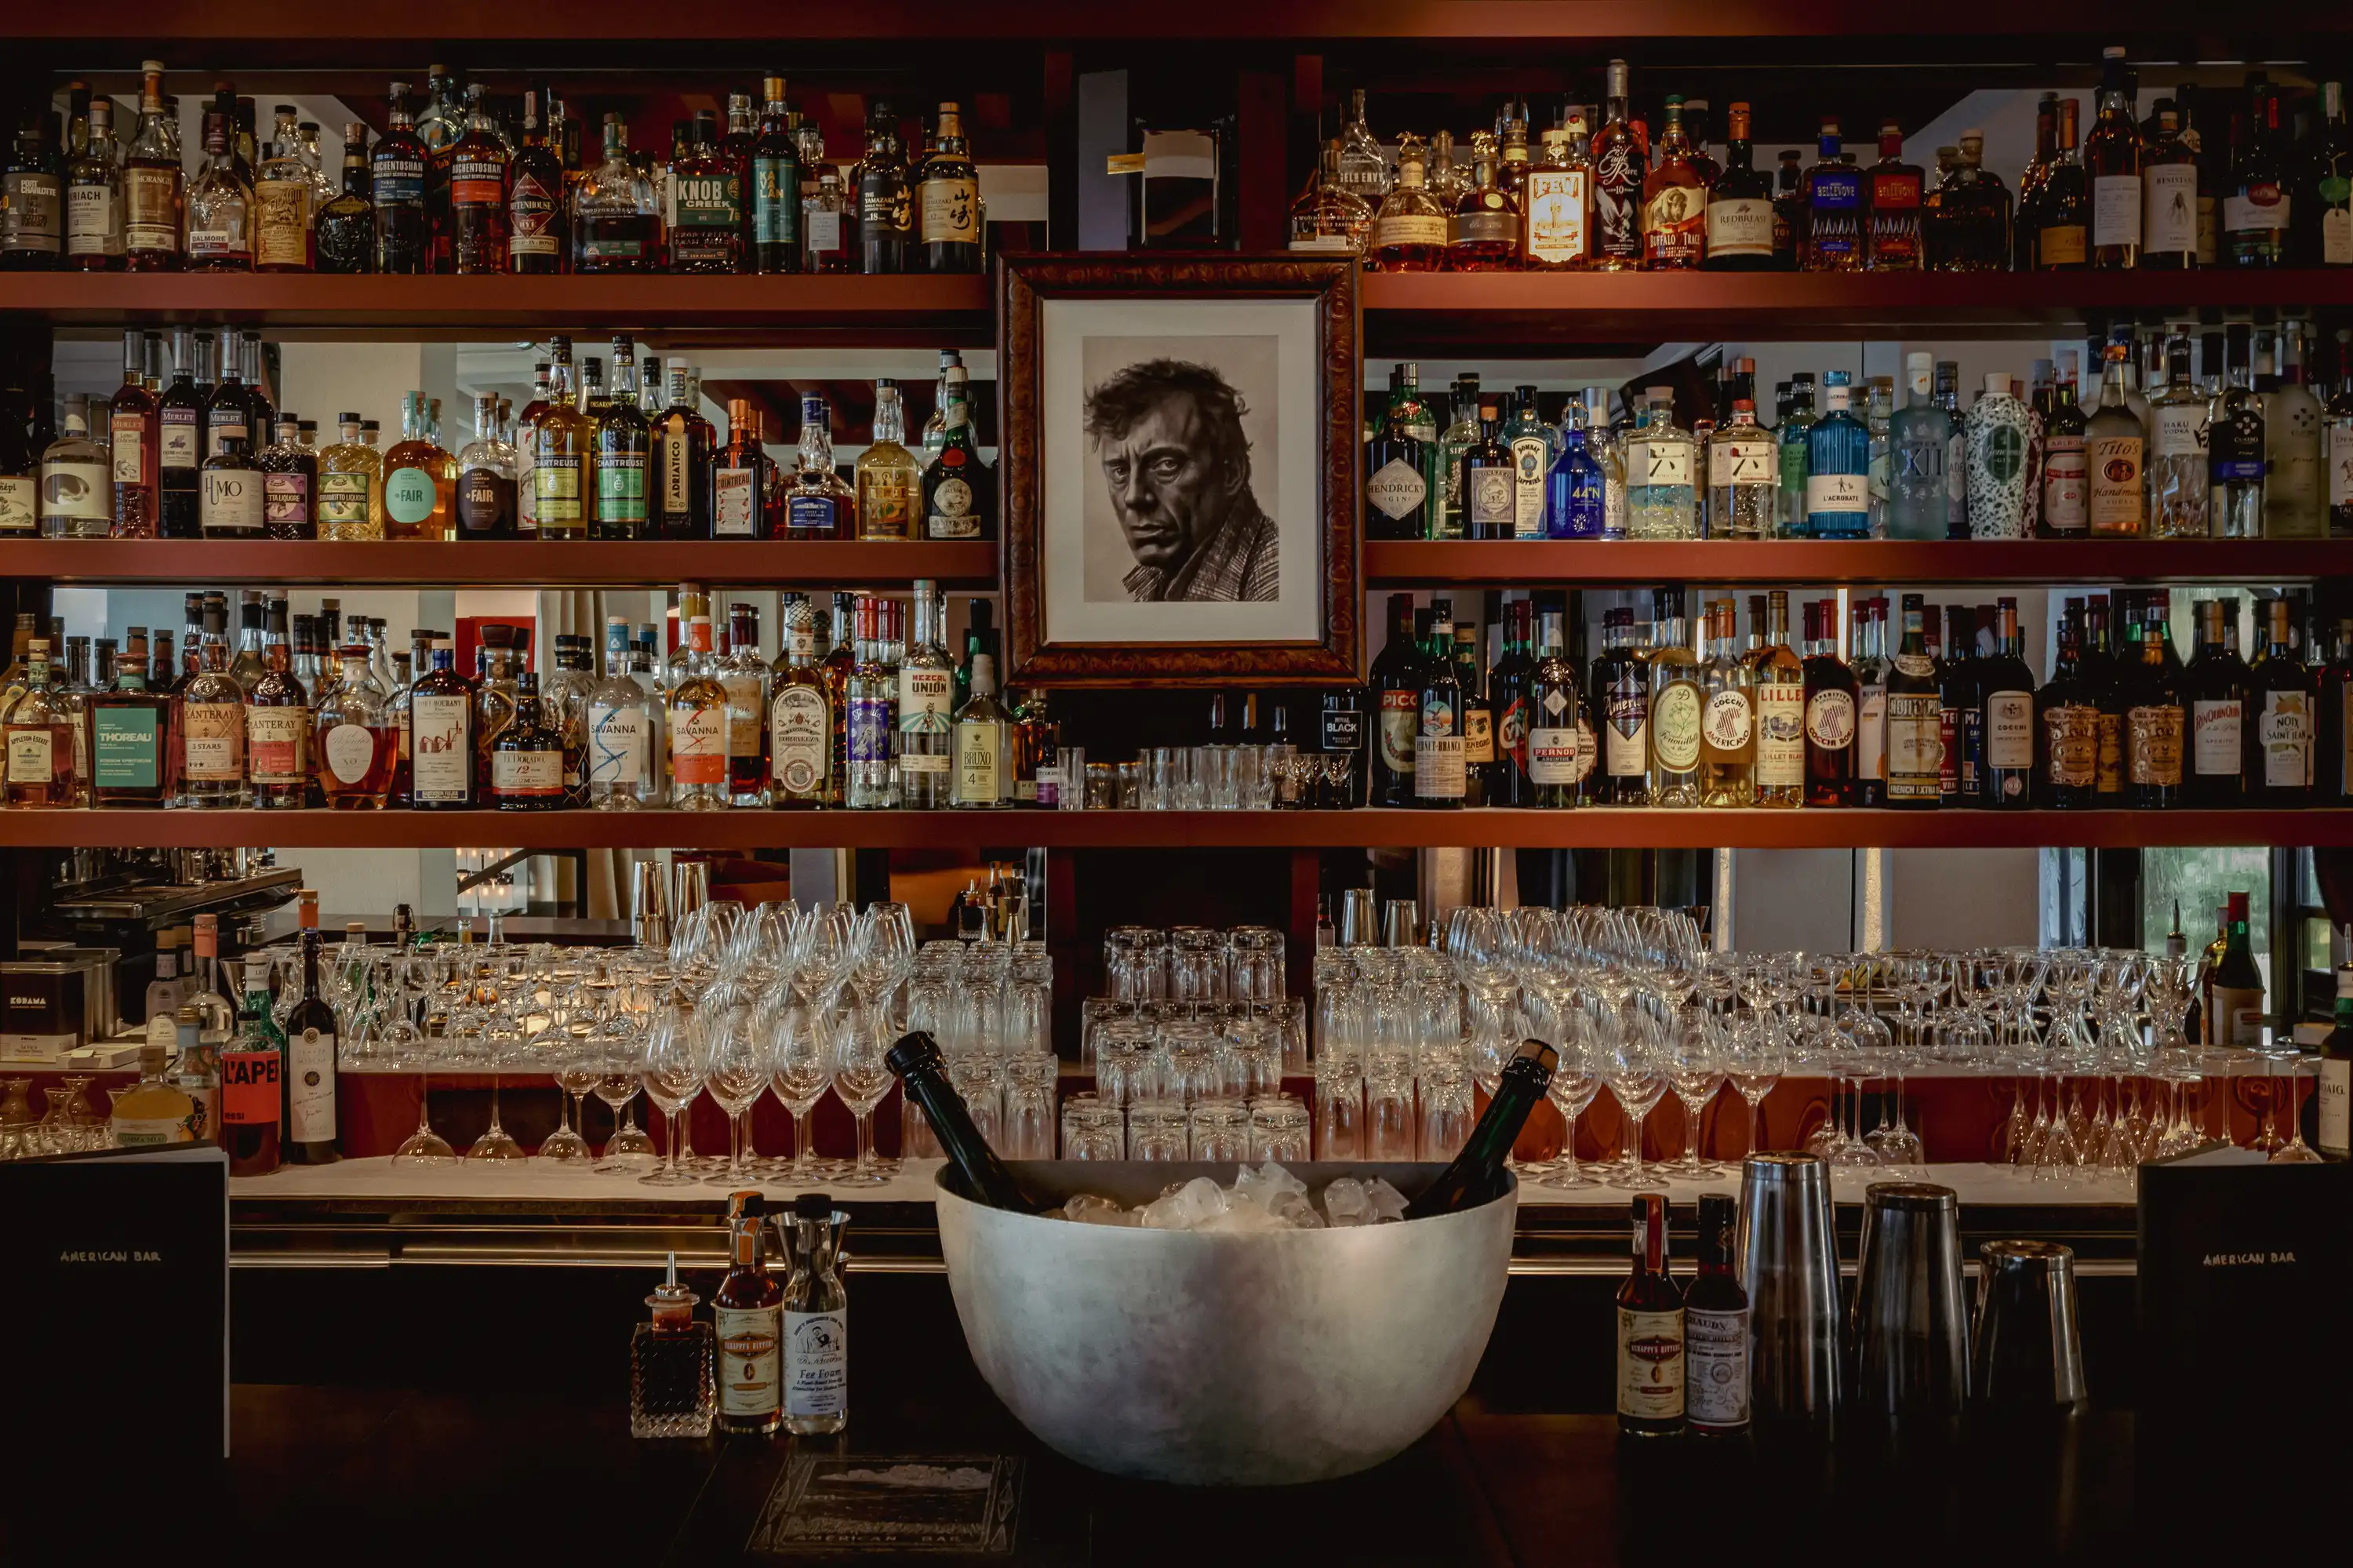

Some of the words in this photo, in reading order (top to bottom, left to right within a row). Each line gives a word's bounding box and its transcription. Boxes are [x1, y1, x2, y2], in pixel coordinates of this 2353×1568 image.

[373, 161, 424, 173] AUCHENTOSHAN
[452, 162, 502, 174] AUCHENTOSHAN
[21, 180, 38, 188] PORT
[125, 174, 173, 185] GLMORANGIE
[21, 186, 56, 196] CHARLOTTE
[678, 180, 722, 199] KNOB
[1534, 177, 1579, 198] FEW
[1616, 185, 1624, 194] 10
[1720, 214, 1766, 224] REDBREAST
[1650, 234, 1676, 248] BUFFALO
[1683, 232, 1701, 246] TRACE
[162, 412, 194, 421] MERLET
[210, 413, 239, 422] MERLET
[2098, 438, 2139, 457] Tito's
[534, 459, 579, 467] CHARTREUSE
[597, 460, 644, 468] CHARTREUSE
[672, 441, 681, 499] ADRIATICO
[717, 473, 751, 489] COINTREAU
[1368, 484, 1424, 493] HENDRICK'S
[400, 489, 423, 502] FAIR
[471, 489, 493, 503] FAIR
[1714, 699, 1744, 709] COCCHI
[1326, 723, 1357, 733] BLACK
[2276, 717, 2299, 728] NOIX
[591, 725, 637, 734] SAVANNA
[676, 726, 718, 735] SAVANNA
[2267, 729, 2291, 740] SAINT
[2291, 730, 2307, 741] JEAN
[10, 736, 32, 745] APPLETON
[33, 735, 51, 746] ESTATE
[99, 733, 152, 742] THOREAU
[1706, 729, 1750, 747] AMERICANO
[1809, 727, 1837, 746] COCCHI
[514, 753, 546, 764] DORADO
[964, 751, 991, 766] BRUXO
[515, 765, 529, 775] 12
[968, 773, 976, 785] 4
[1889, 784, 1915, 795] FRENCH
[9, 996, 47, 1006] KODAMA
[60, 1251, 127, 1262] AMERICAN
[133, 1251, 162, 1261] BAR
[2202, 1253, 2265, 1266] AMERICAN
[2270, 1252, 2297, 1263] BAR
[799, 1370, 816, 1380] Fee
[817, 1368, 842, 1379] Foam
[791, 1533, 899, 1542] AMERICAN
[921, 1533, 962, 1542] BAR
